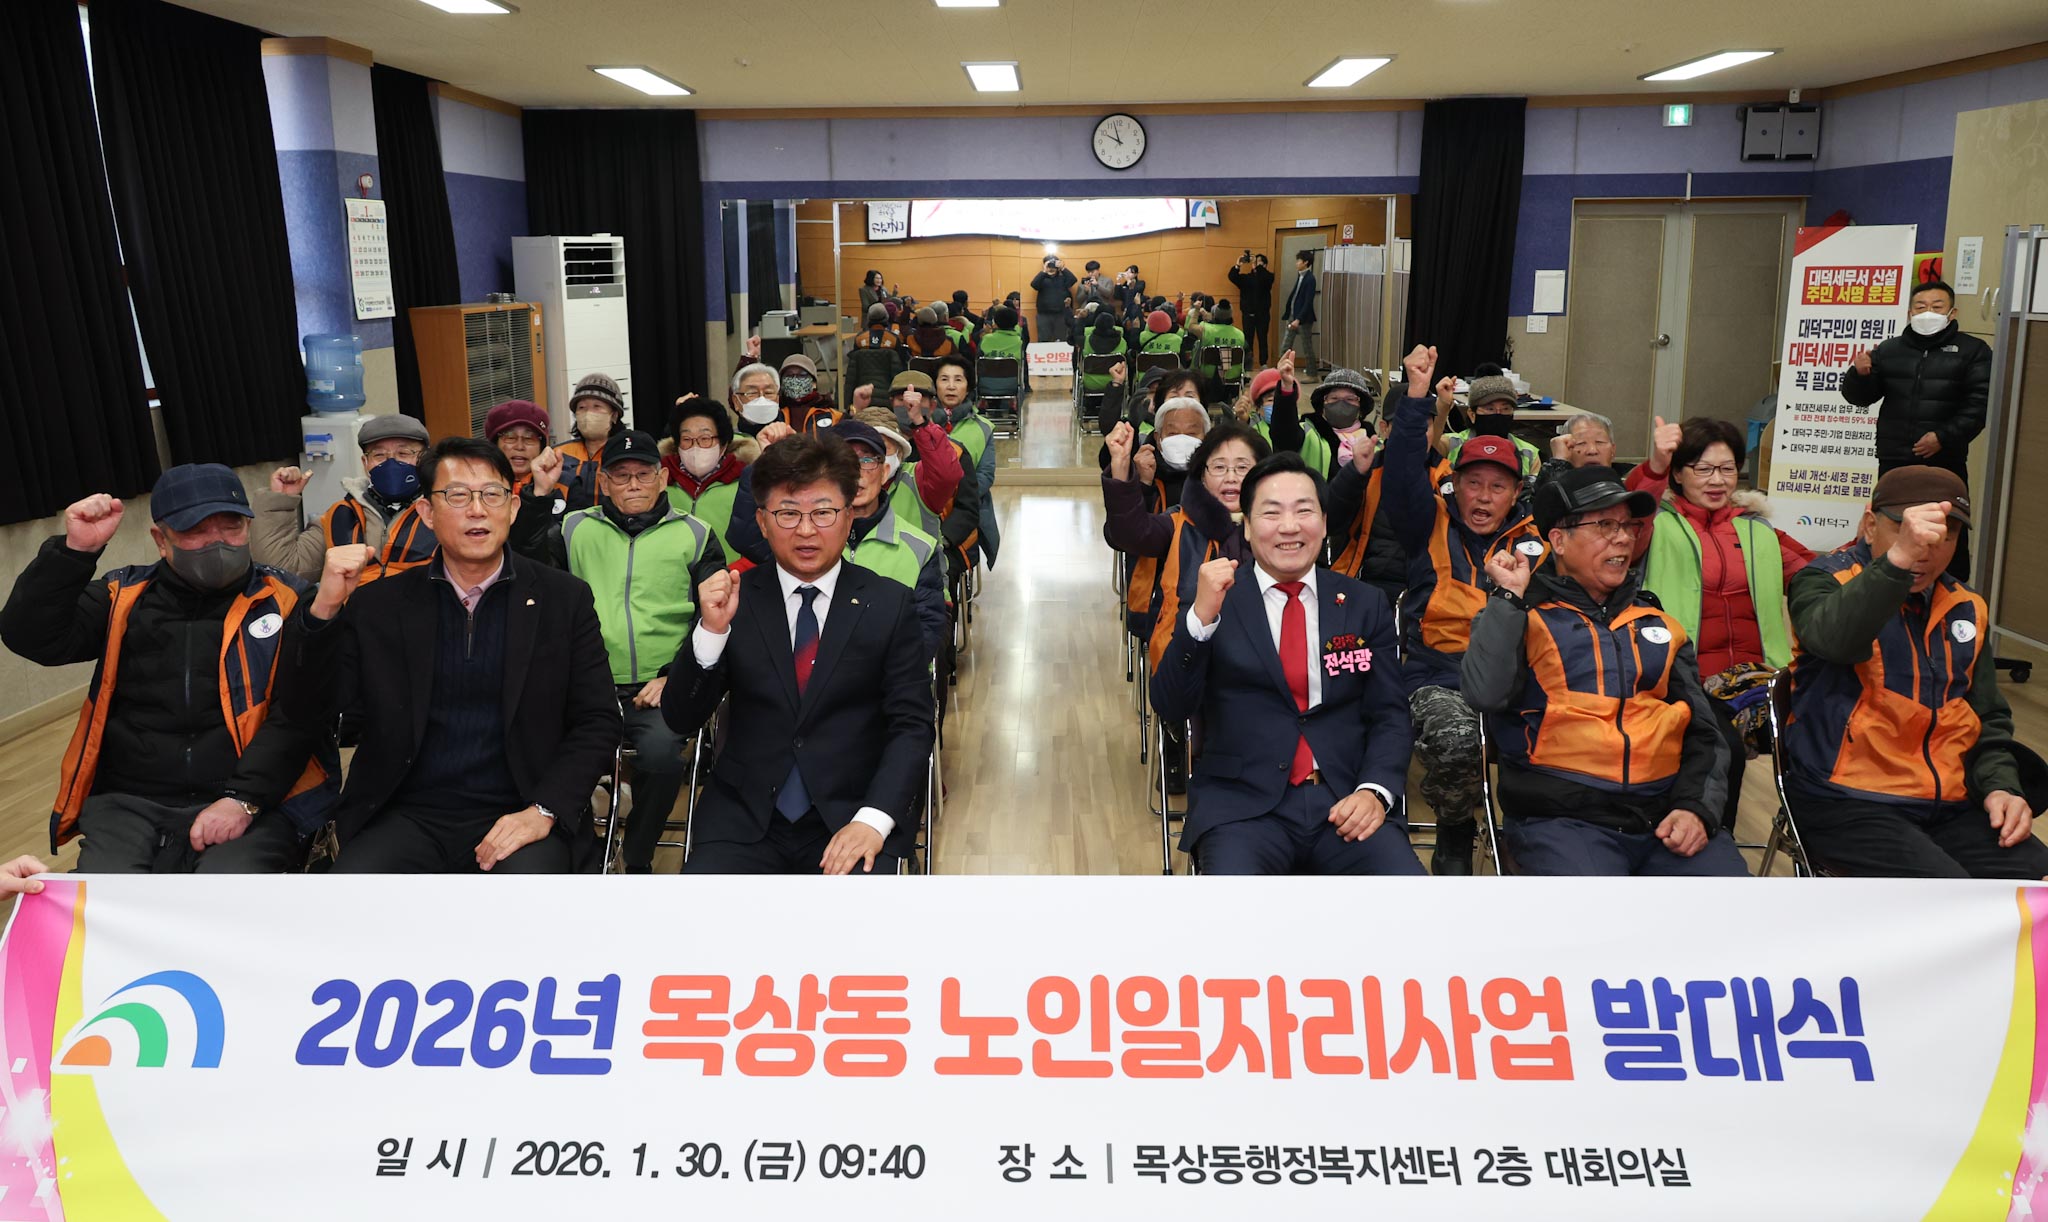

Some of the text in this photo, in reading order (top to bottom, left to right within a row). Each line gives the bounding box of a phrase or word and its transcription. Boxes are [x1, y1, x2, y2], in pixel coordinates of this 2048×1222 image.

[364, 206, 369, 218] 1
[1808, 269, 1898, 286] 대덕세무서 신설
[1807, 286, 1896, 303] 주민 서명 운동
[1798, 319, 1857, 339] 대덕구민의
[1860, 319, 1884, 340] 염원
[1795, 371, 1808, 391] 꼭
[1795, 403, 1837, 413] 북대전세무서
[1839, 405, 1853, 414] 업무
[1851, 416, 1866, 424] 59%
[1792, 428, 1812, 438] 대덕구
[1844, 430, 1872, 440] 민원처리
[1790, 444, 1818, 453] 대덕구민
[1820, 445, 1842, 455] 세무서
[1843, 446, 1865, 456] 원거리
[1789, 469, 1873, 485] 납세 개선·세정 균형!
[1777, 481, 1820, 494] 대덕세무서
[1823, 484, 1850, 496] 설치로
[1814, 517, 1850, 529] 대덕구
[1323, 648, 1373, 677] 전석광
[296, 974, 1874, 1081] 2026년 목상동 노인일자리사업 발대식
[376, 1138, 925, 1183] 일 시 2026. 1. 30. (금) 09:40
[998, 1144, 1691, 1188] 장 소 목상동행정복지센터 2층 대회의실
